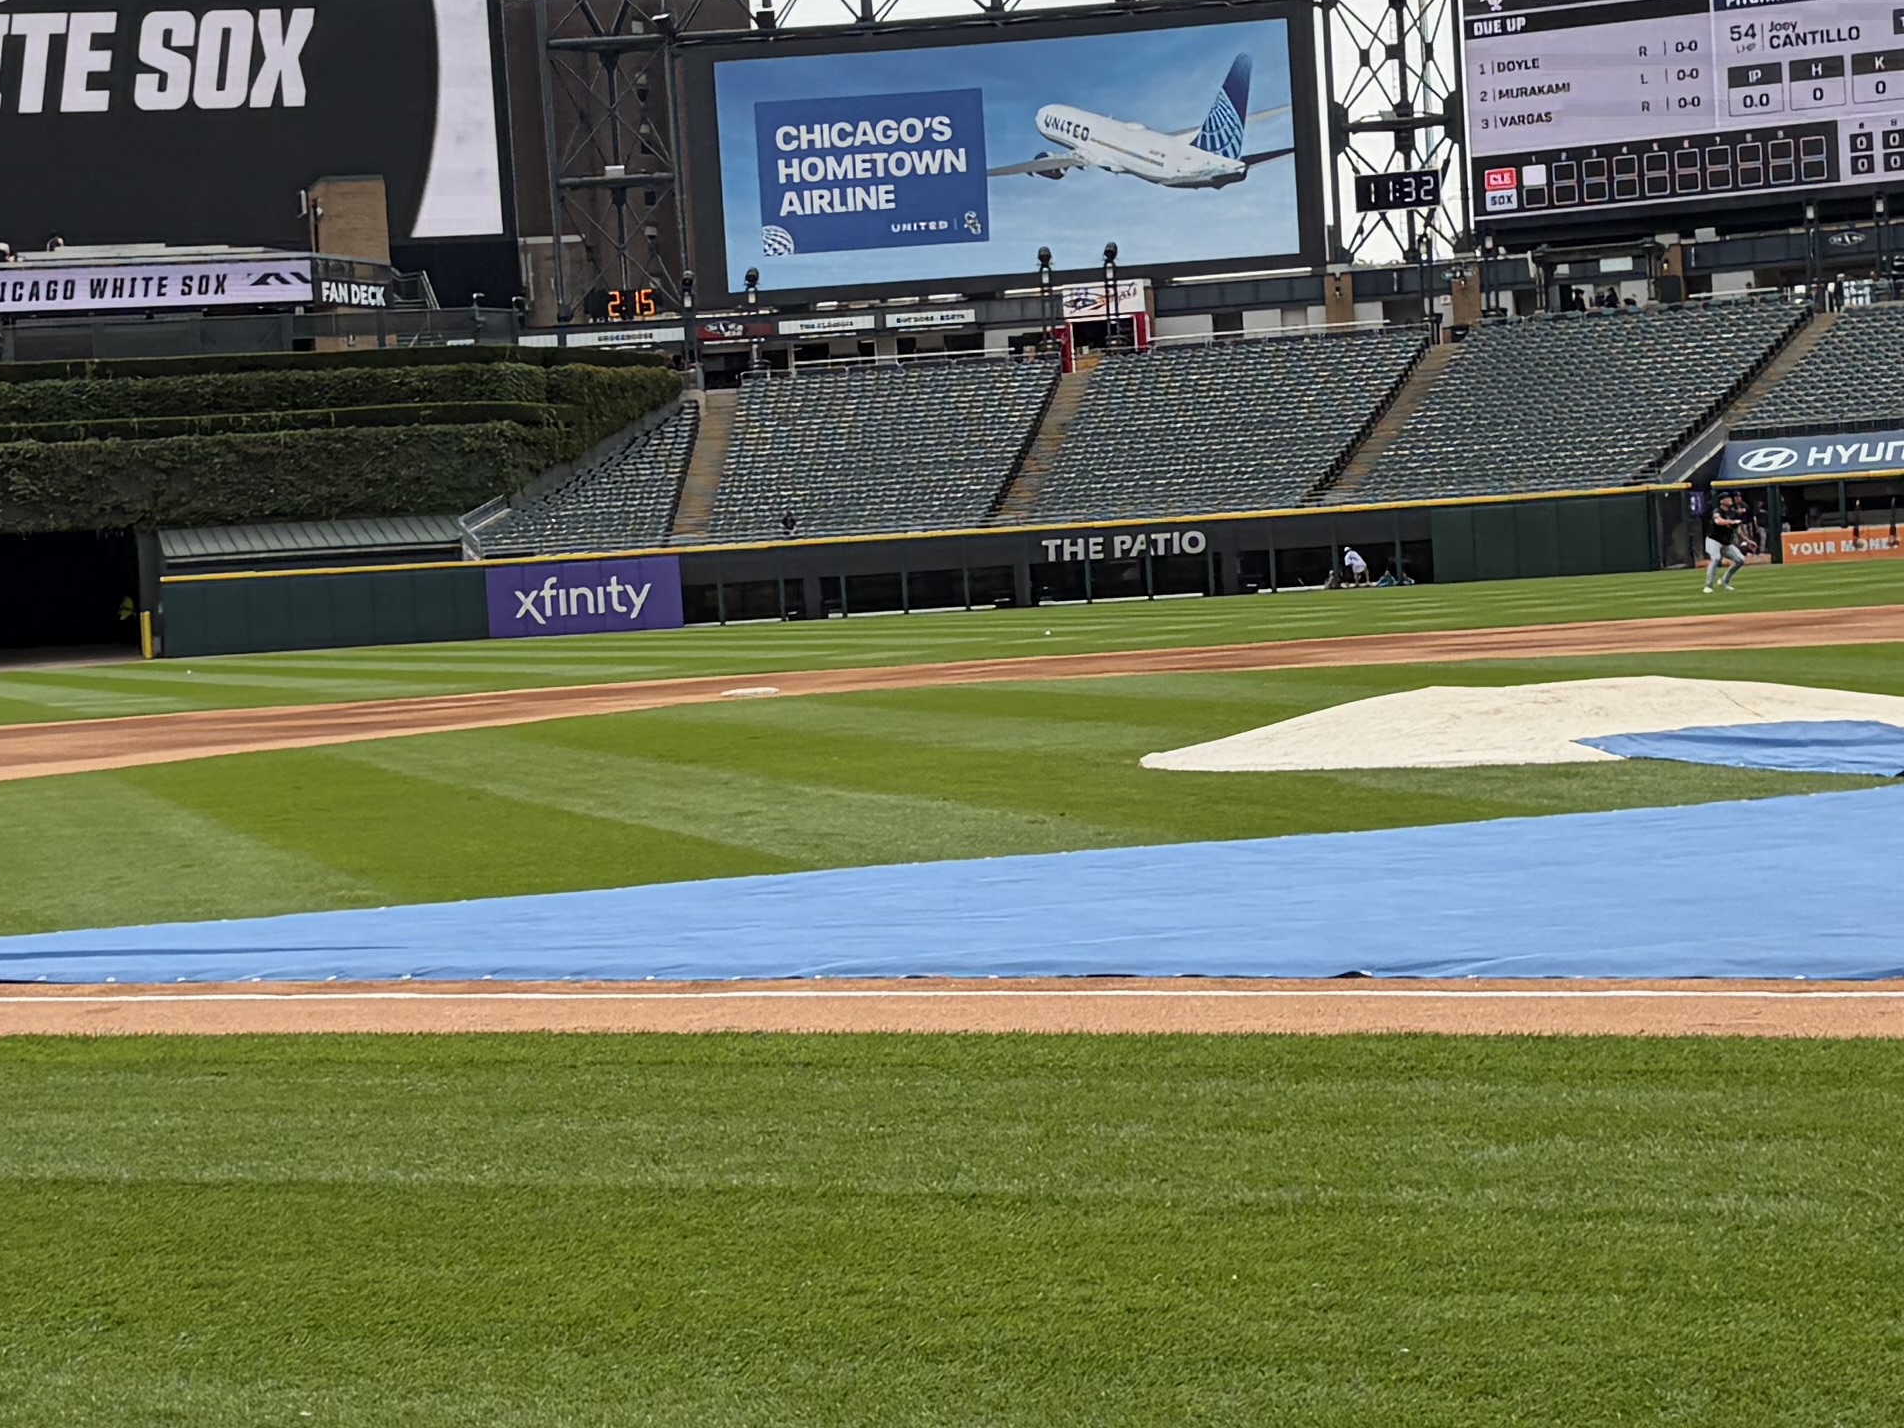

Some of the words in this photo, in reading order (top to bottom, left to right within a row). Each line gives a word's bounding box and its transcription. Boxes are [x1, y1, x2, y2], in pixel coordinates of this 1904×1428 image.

[1473, 18, 1502, 36] DUE
[1506, 17, 1526, 32] UP
[1729, 23, 1757, 42] 54
[1769, 26, 1860, 49] CANTILLO
[134, 8, 315, 111] SOX
[1639, 46, 1647, 57] R
[1675, 40, 1698, 53] 0-0
[1479, 64, 1485, 75] 1
[1497, 58, 1540, 73] DOYLE
[1641, 74, 1648, 85] L
[1677, 68, 1700, 81] 0-0
[1748, 70, 1761, 83] IP
[1811, 63, 1823, 76] H
[1874, 56, 1885, 70] K
[1480, 91, 1488, 102] 2
[1498, 82, 1571, 100] MURAKAMI
[1641, 101, 1650, 112] R
[1678, 95, 1701, 109] 0-0
[1743, 93, 1770, 108] 0.0
[1812, 87, 1824, 101] 0
[1875, 81, 1886, 94] 0
[775, 115, 953, 151] CHICAGO'S
[1045, 114, 1090, 142] UNITED
[1481, 118, 1489, 129] 3
[1499, 112, 1553, 128] VARGAS
[1856, 136, 1867, 149] 0
[1889, 133, 1900, 147] 0
[777, 148, 967, 184] HOMETOWN
[1857, 158, 1868, 172] 0
[1890, 155, 1901, 168] 0
[780, 184, 896, 217] AIRLINE
[1370, 175, 1434, 203] 11:32
[1490, 194, 1513, 206] SOX
[891, 220, 949, 233] UNITED
[89, 275, 169, 300] WHITE
[181, 273, 228, 296] SOX
[321, 281, 350, 304] FAN
[351, 284, 386, 307] DECK
[1043, 536, 1105, 562] THE
[1113, 530, 1206, 559] PATIO
[1788, 538, 1837, 556] YOUR
[514, 574, 652, 622] xfinity
